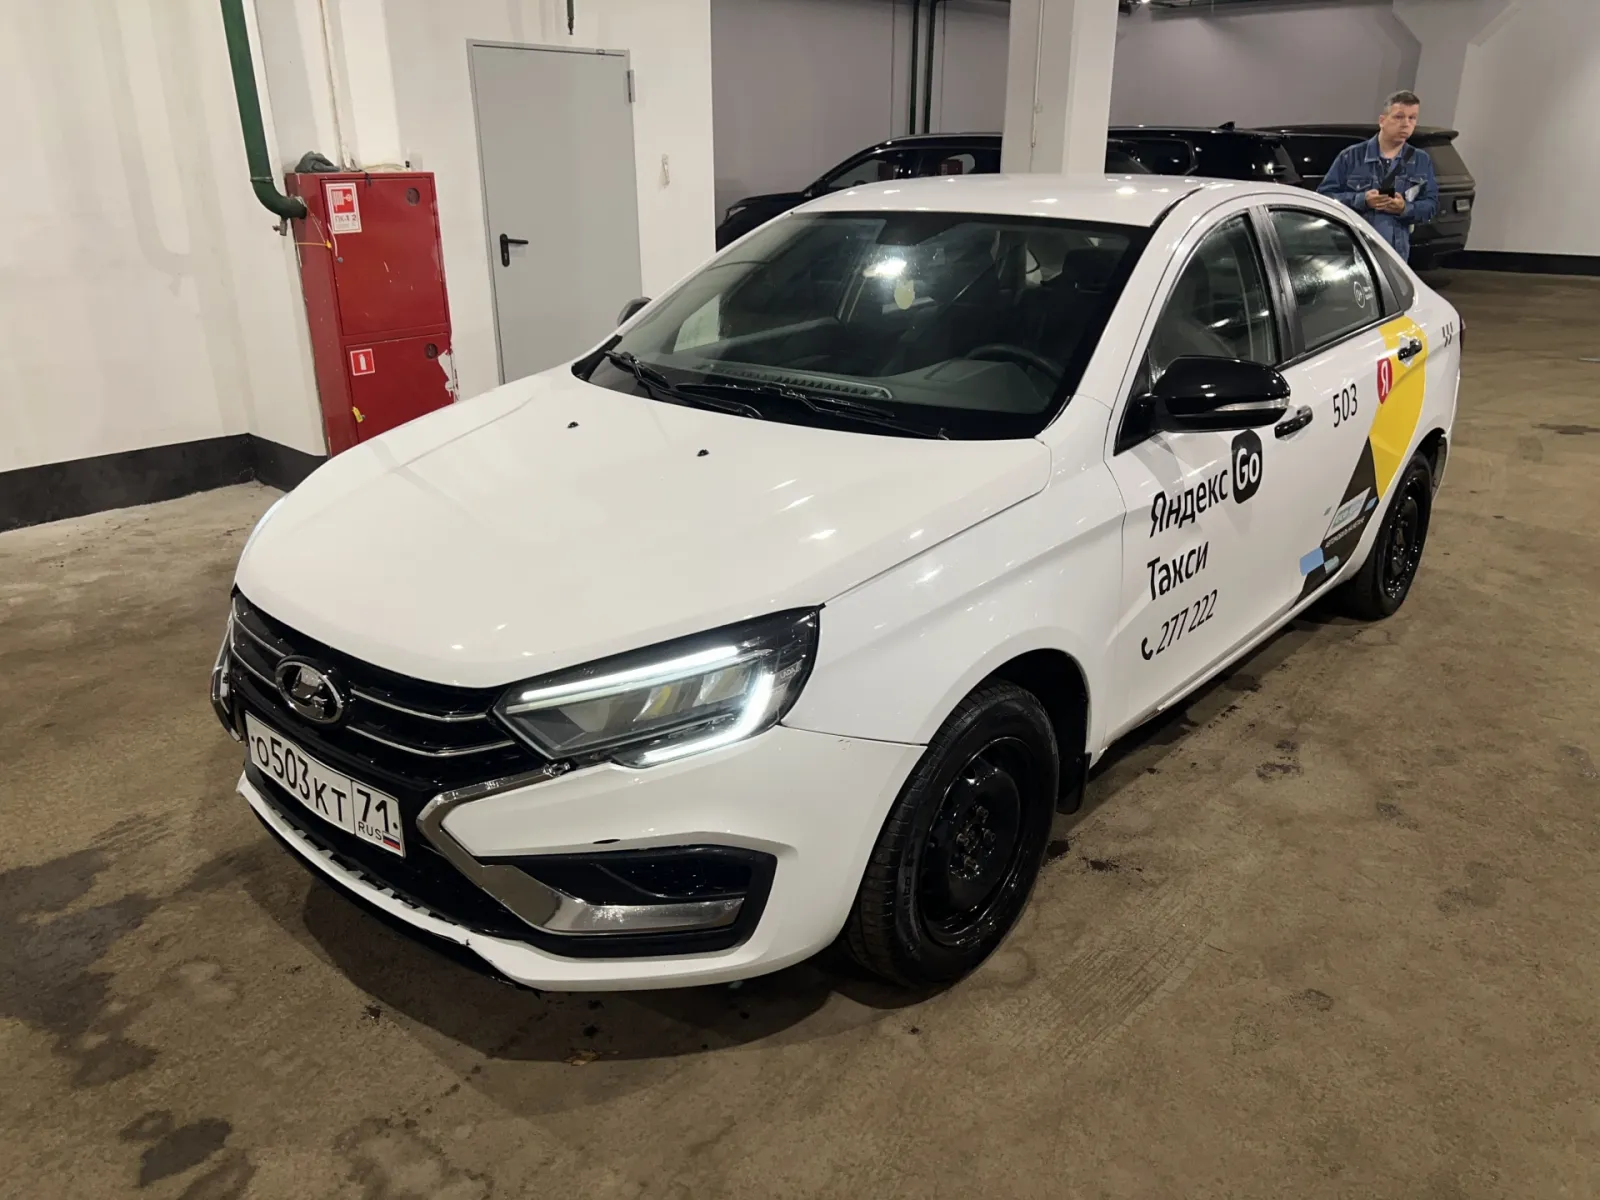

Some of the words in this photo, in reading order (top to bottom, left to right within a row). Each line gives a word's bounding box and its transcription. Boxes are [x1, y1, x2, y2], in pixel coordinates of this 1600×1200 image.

[1380, 360, 1389, 396] Я
[1332, 383, 1358, 427] 503
[1150, 469, 1228, 538] Яндекс
[1235, 447, 1260, 491] Go
[1147, 541, 1209, 600] Такси
[1155, 606, 1188, 656] 277
[1188, 589, 1218, 633] 222
[356, 787, 390, 834] 71
[358, 821, 382, 841] RUS
